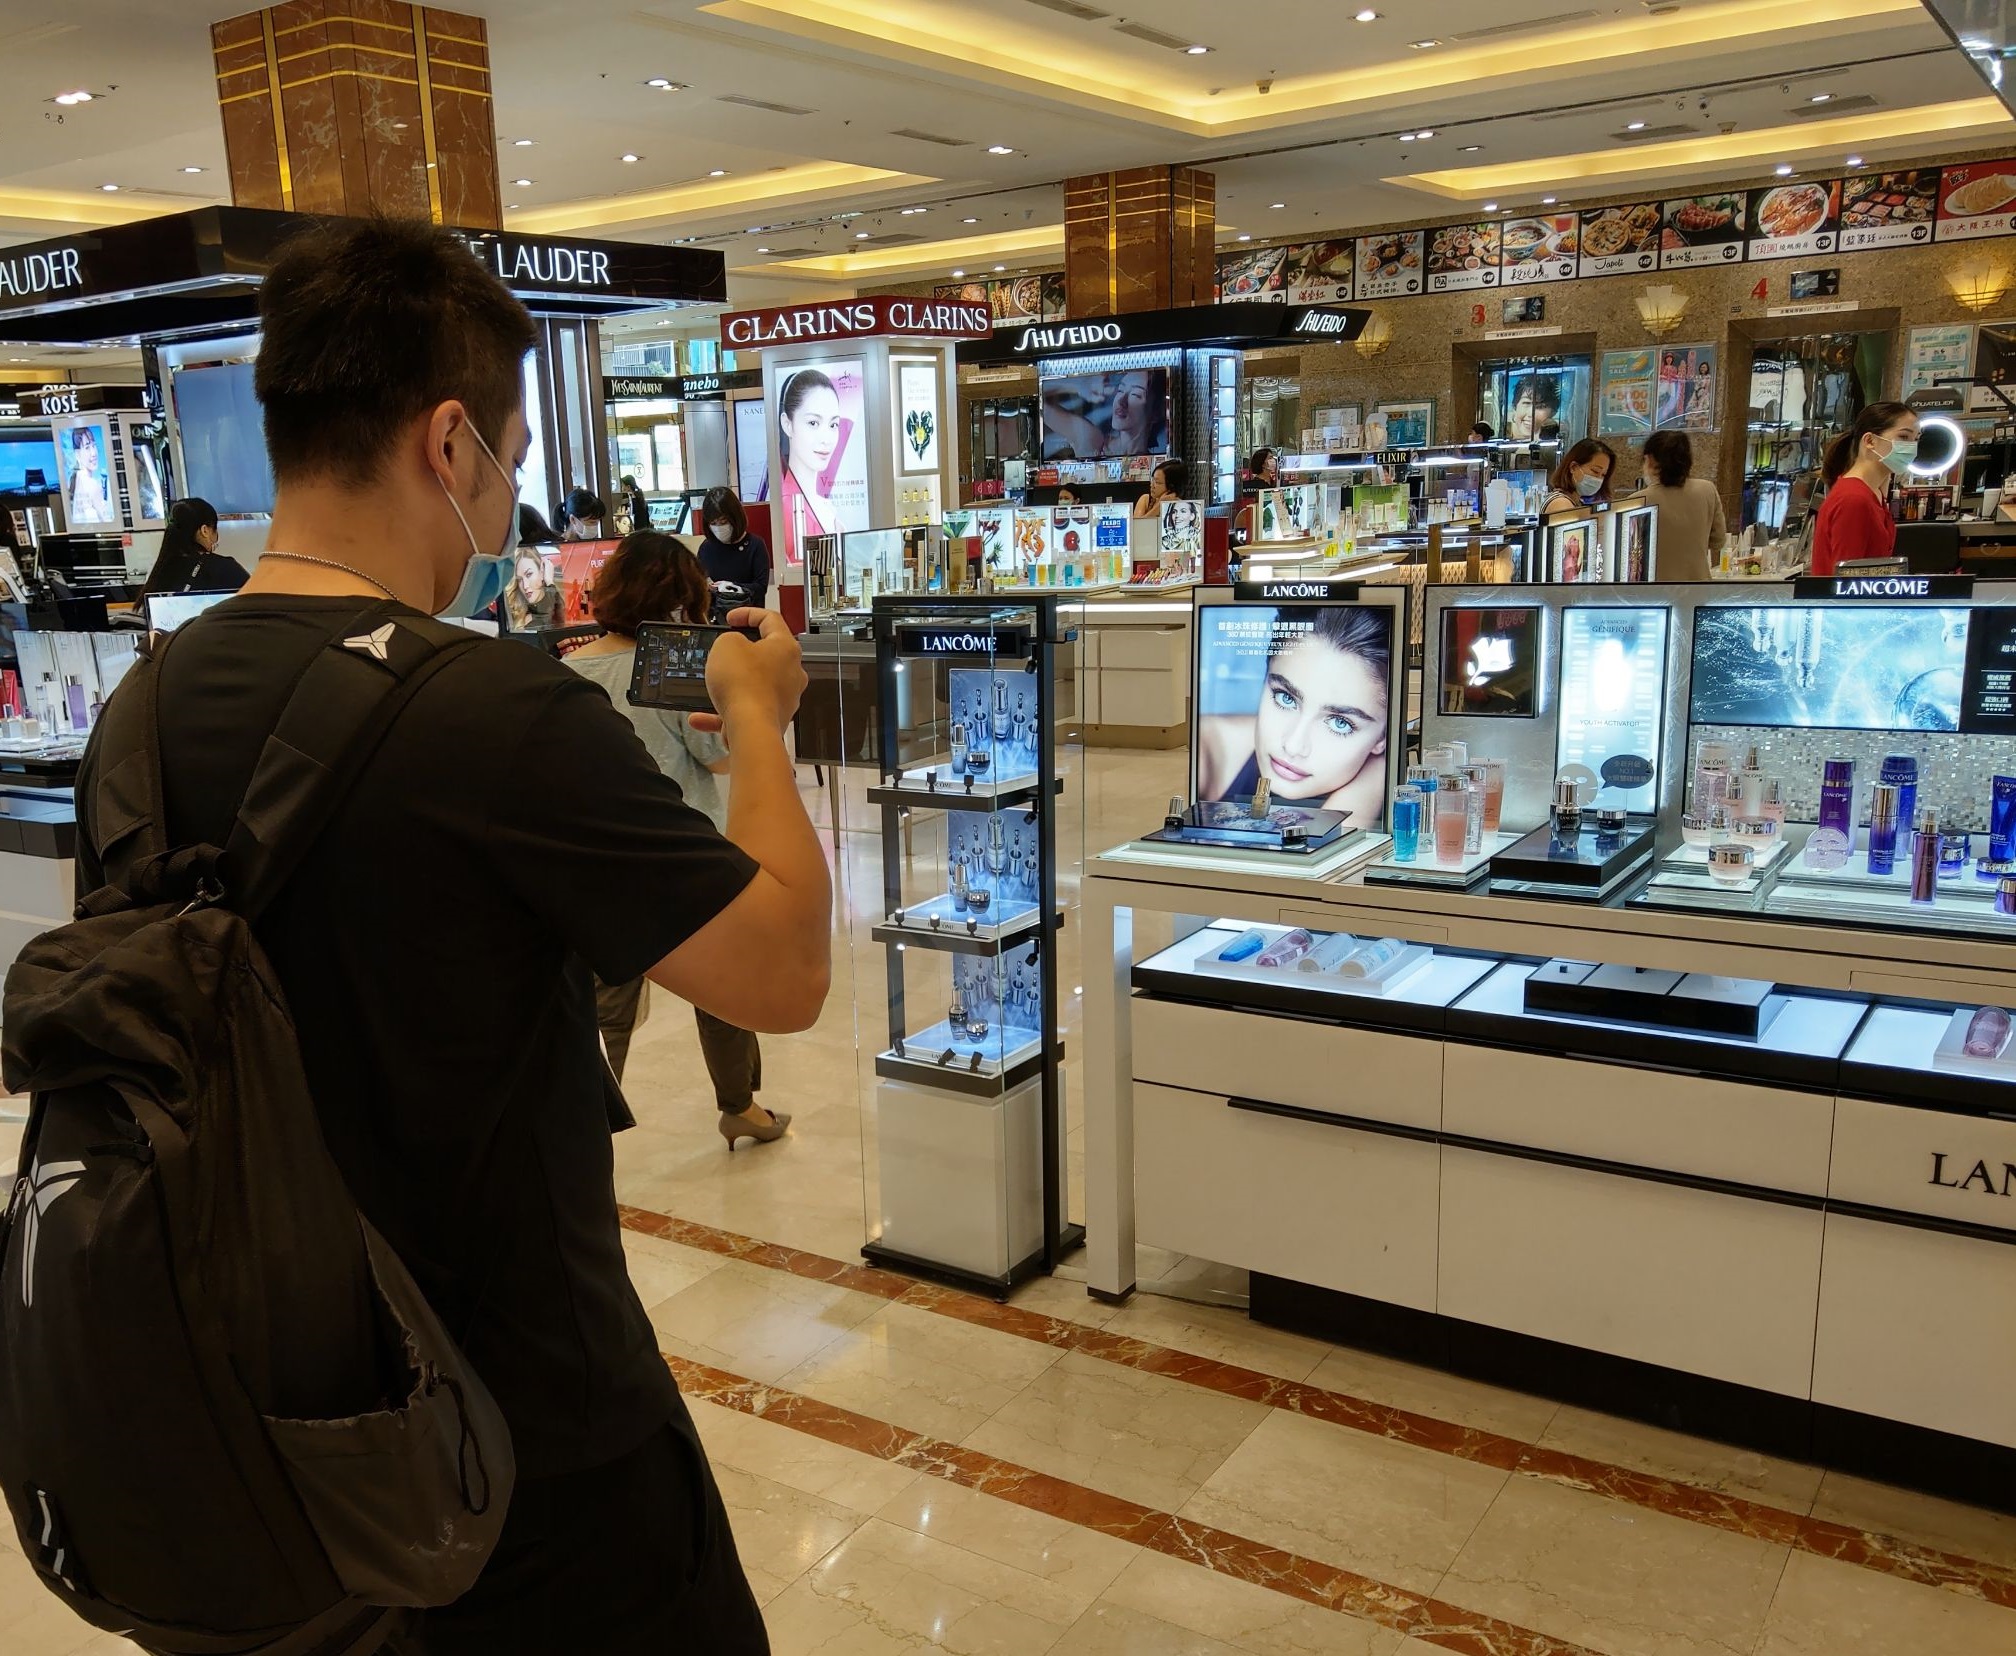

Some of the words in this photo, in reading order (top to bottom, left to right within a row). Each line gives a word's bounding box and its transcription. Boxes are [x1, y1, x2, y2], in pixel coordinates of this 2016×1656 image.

[1911, 229, 1926, 238] 13F
[1817, 238, 1831, 247] 13F
[1723, 248, 1737, 257] 13F
[496, 242, 611, 285] LAUDER
[1639, 256, 1652, 266] 14F
[1560, 265, 1572, 274] 14F
[1407, 281, 1418, 290] 14F
[1482, 274, 1495, 282] 14F
[1336, 289, 1348, 298] 14F
[1751, 277, 1769, 300] 4
[888, 303, 988, 332] CLARINS
[1295, 309, 1347, 334] SHISEIDO
[1471, 304, 1486, 325] 3
[727, 304, 877, 343] CLARINS
[1014, 322, 1122, 352] SHISEIDO
[683, 375, 720, 392] anebo
[41, 391, 80, 415] KOSÉ
[1376, 452, 1408, 465] ELIXIR
[1263, 583, 1328, 597] LANCÔME
[1835, 579, 1930, 595] LANCÔME
[922, 633, 998, 651] LANCÔME
